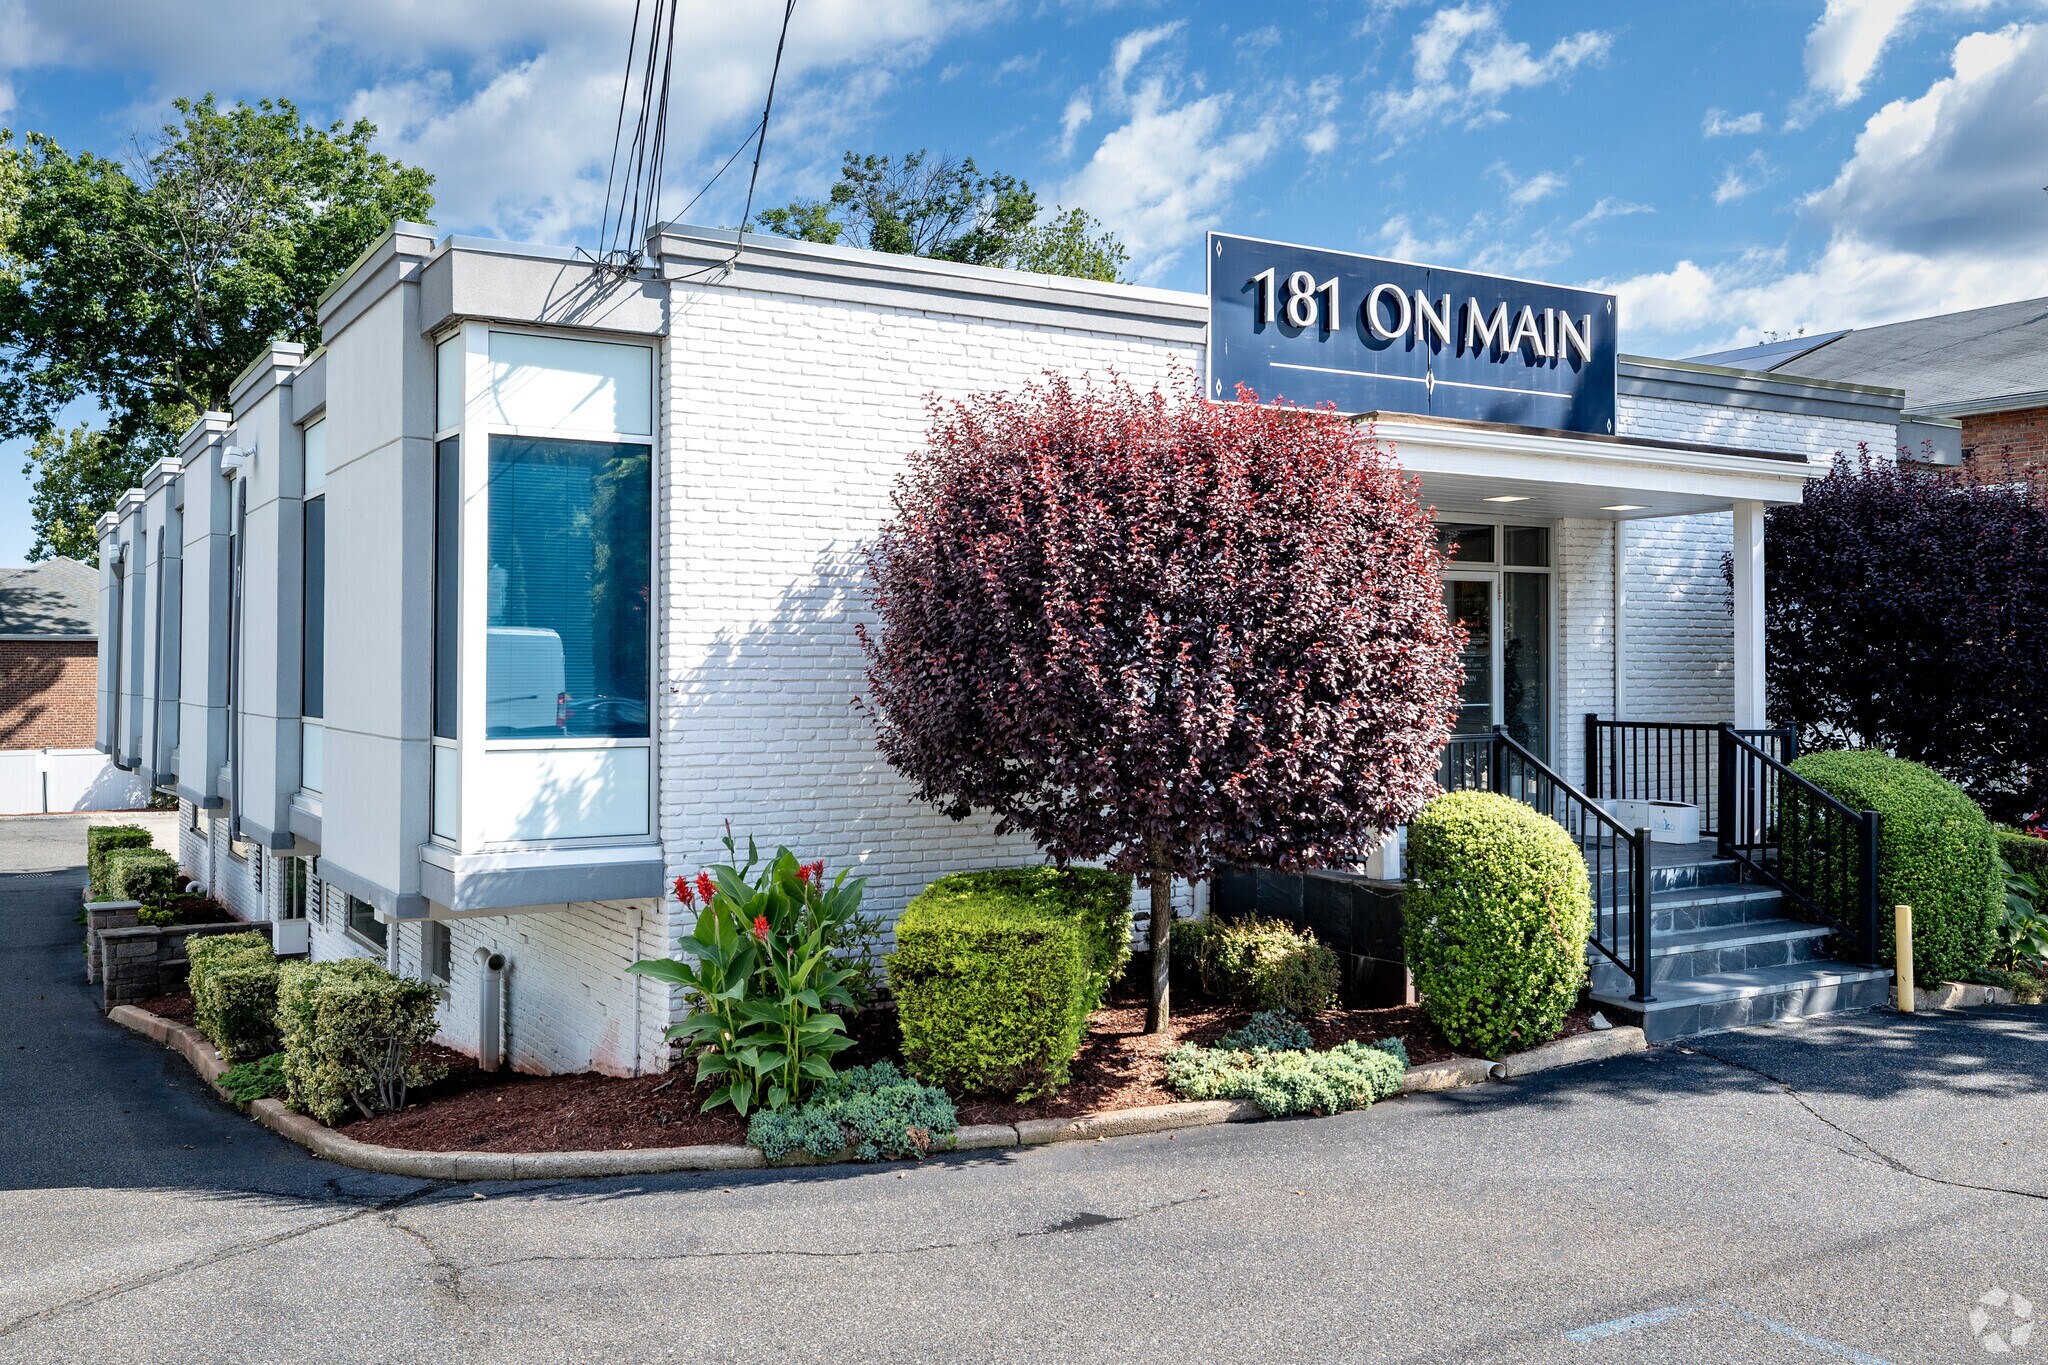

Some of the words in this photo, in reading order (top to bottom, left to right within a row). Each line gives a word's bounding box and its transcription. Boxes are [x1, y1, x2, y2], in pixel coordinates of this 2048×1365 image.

[1251, 267, 1340, 331] 181
[1367, 283, 1451, 345] ON
[1466, 296, 1592, 363] MAIN
